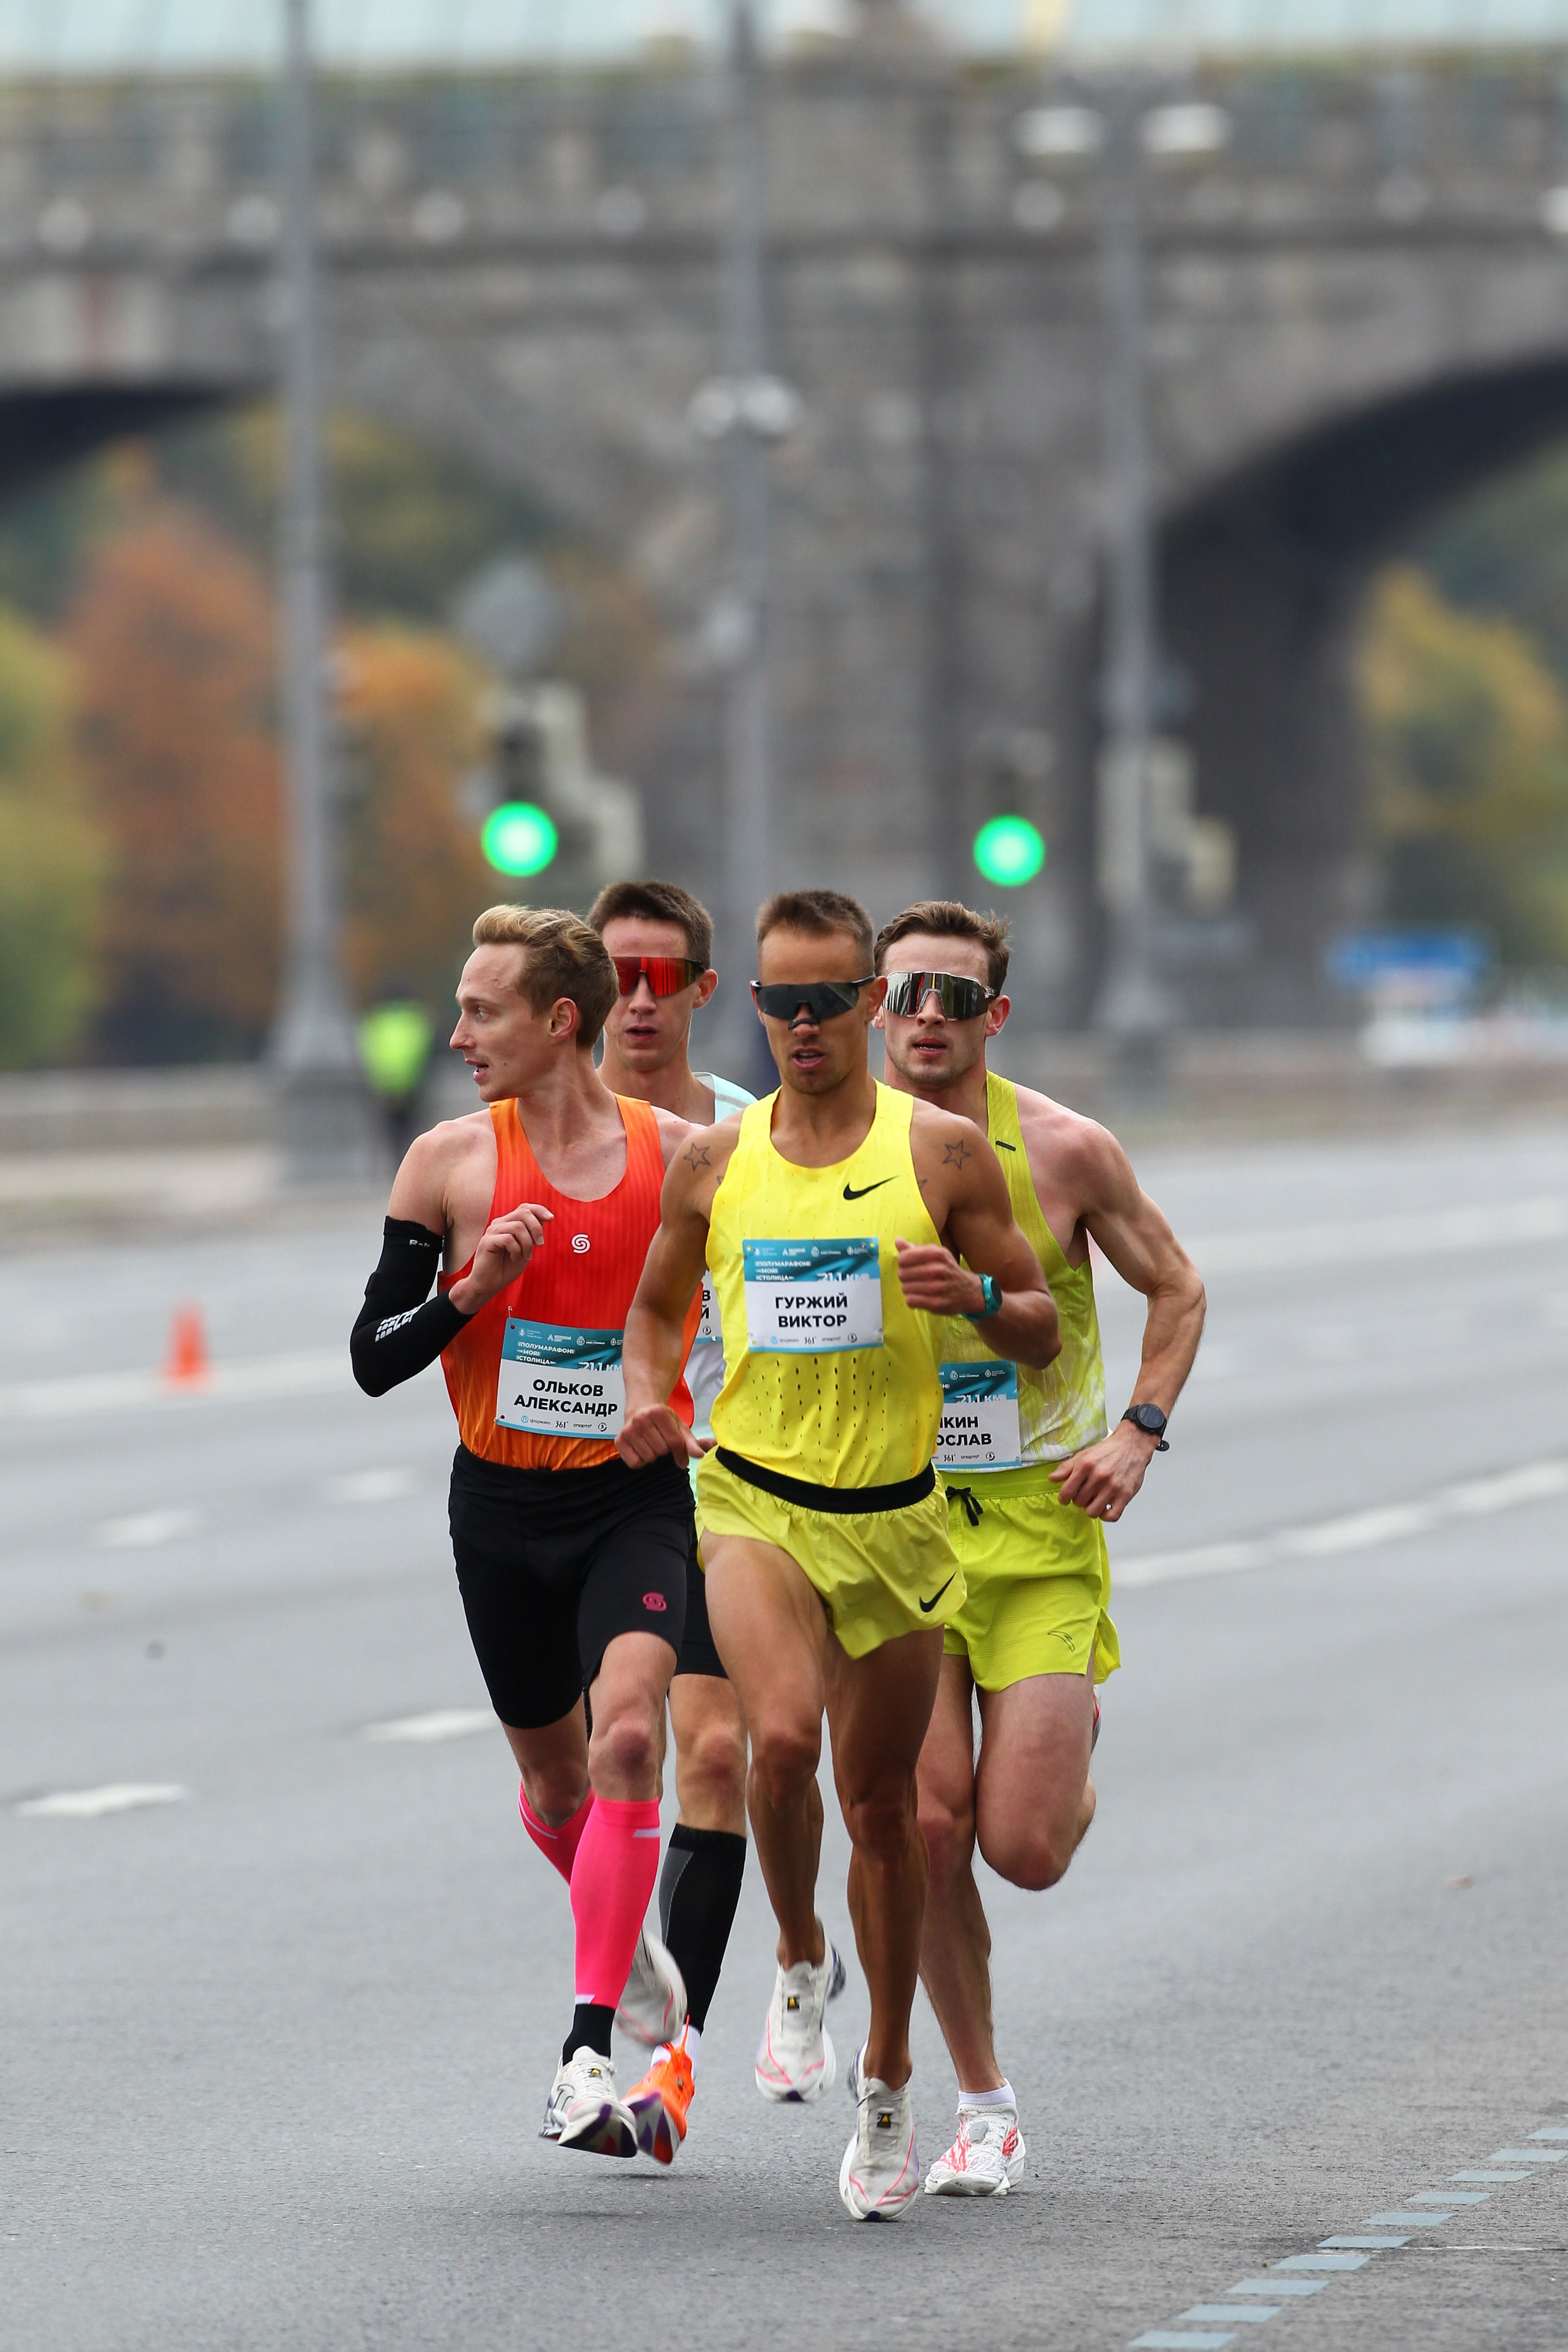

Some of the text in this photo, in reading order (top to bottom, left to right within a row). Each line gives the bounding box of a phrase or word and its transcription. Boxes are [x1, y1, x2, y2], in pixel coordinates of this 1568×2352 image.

[775, 1292, 848, 1309] ГУРЖИЙ
[778, 1315, 847, 1328] ВИКТОР
[519, 1341, 573, 1354] ПОЛУМАРАФОН
[582, 1362, 603, 1371] 21.1
[533, 1379, 603, 1397] ОЛЬКОВ
[960, 1394, 980, 1403] 21.1
[513, 1394, 618, 1417] АЛЕКСАНДР
